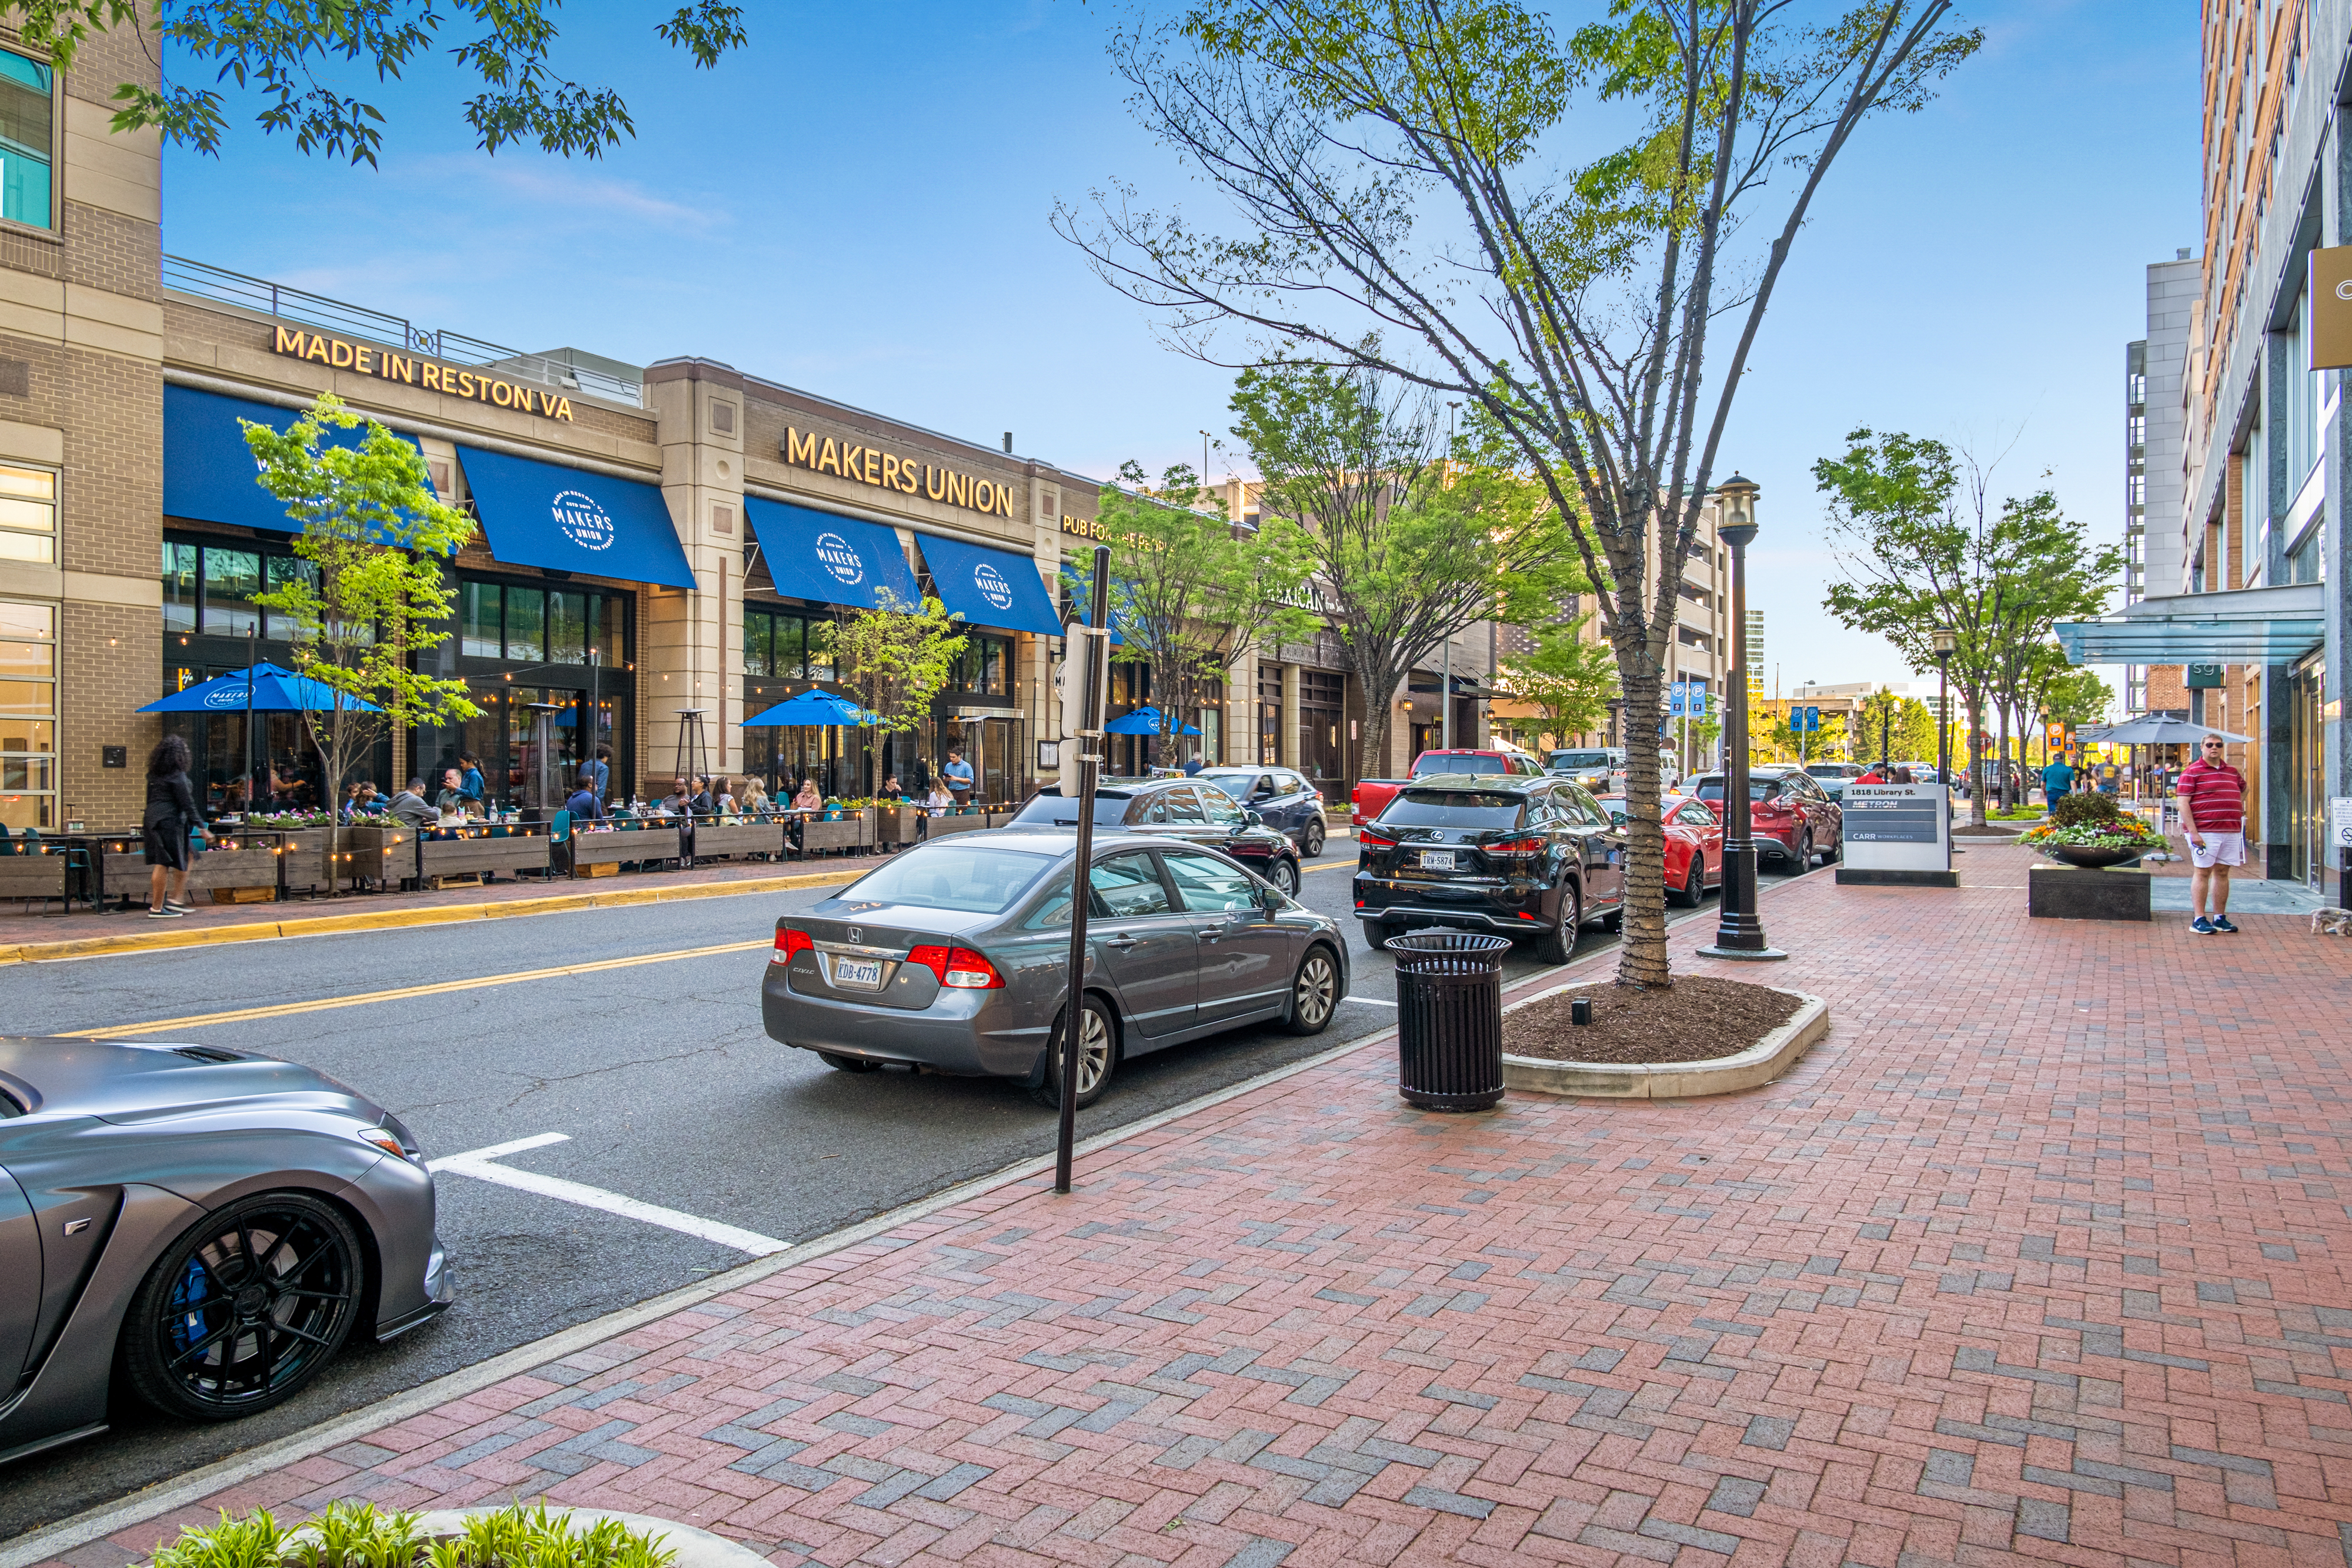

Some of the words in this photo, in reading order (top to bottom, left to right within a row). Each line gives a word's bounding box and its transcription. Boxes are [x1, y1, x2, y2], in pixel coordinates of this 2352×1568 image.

[276, 325, 372, 374] MADE
[382, 352, 412, 383] IN
[423, 362, 532, 412] RESTON
[539, 390, 574, 422] VA
[787, 427, 918, 493] MAKERS
[926, 464, 1013, 517] UNION
[553, 493, 563, 506] MADE
[597, 505, 604, 514] VA
[552, 507, 614, 531] MAKERS
[1063, 514, 1087, 536] PUB
[562, 527, 573, 539] PUB
[574, 538, 588, 548] FOR
[601, 534, 614, 550] PEOPLE
[576, 528, 602, 541] UNION
[816, 547, 862, 568] MAKERS
[834, 566, 855, 576] UNION
[974, 577, 1011, 594] MAKERS
[990, 593, 1006, 602] UNION
[1852, 800, 1898, 808] METRON
[1423, 855, 1452, 865] TRM-5874
[837, 963, 878, 981] KDB-4778
